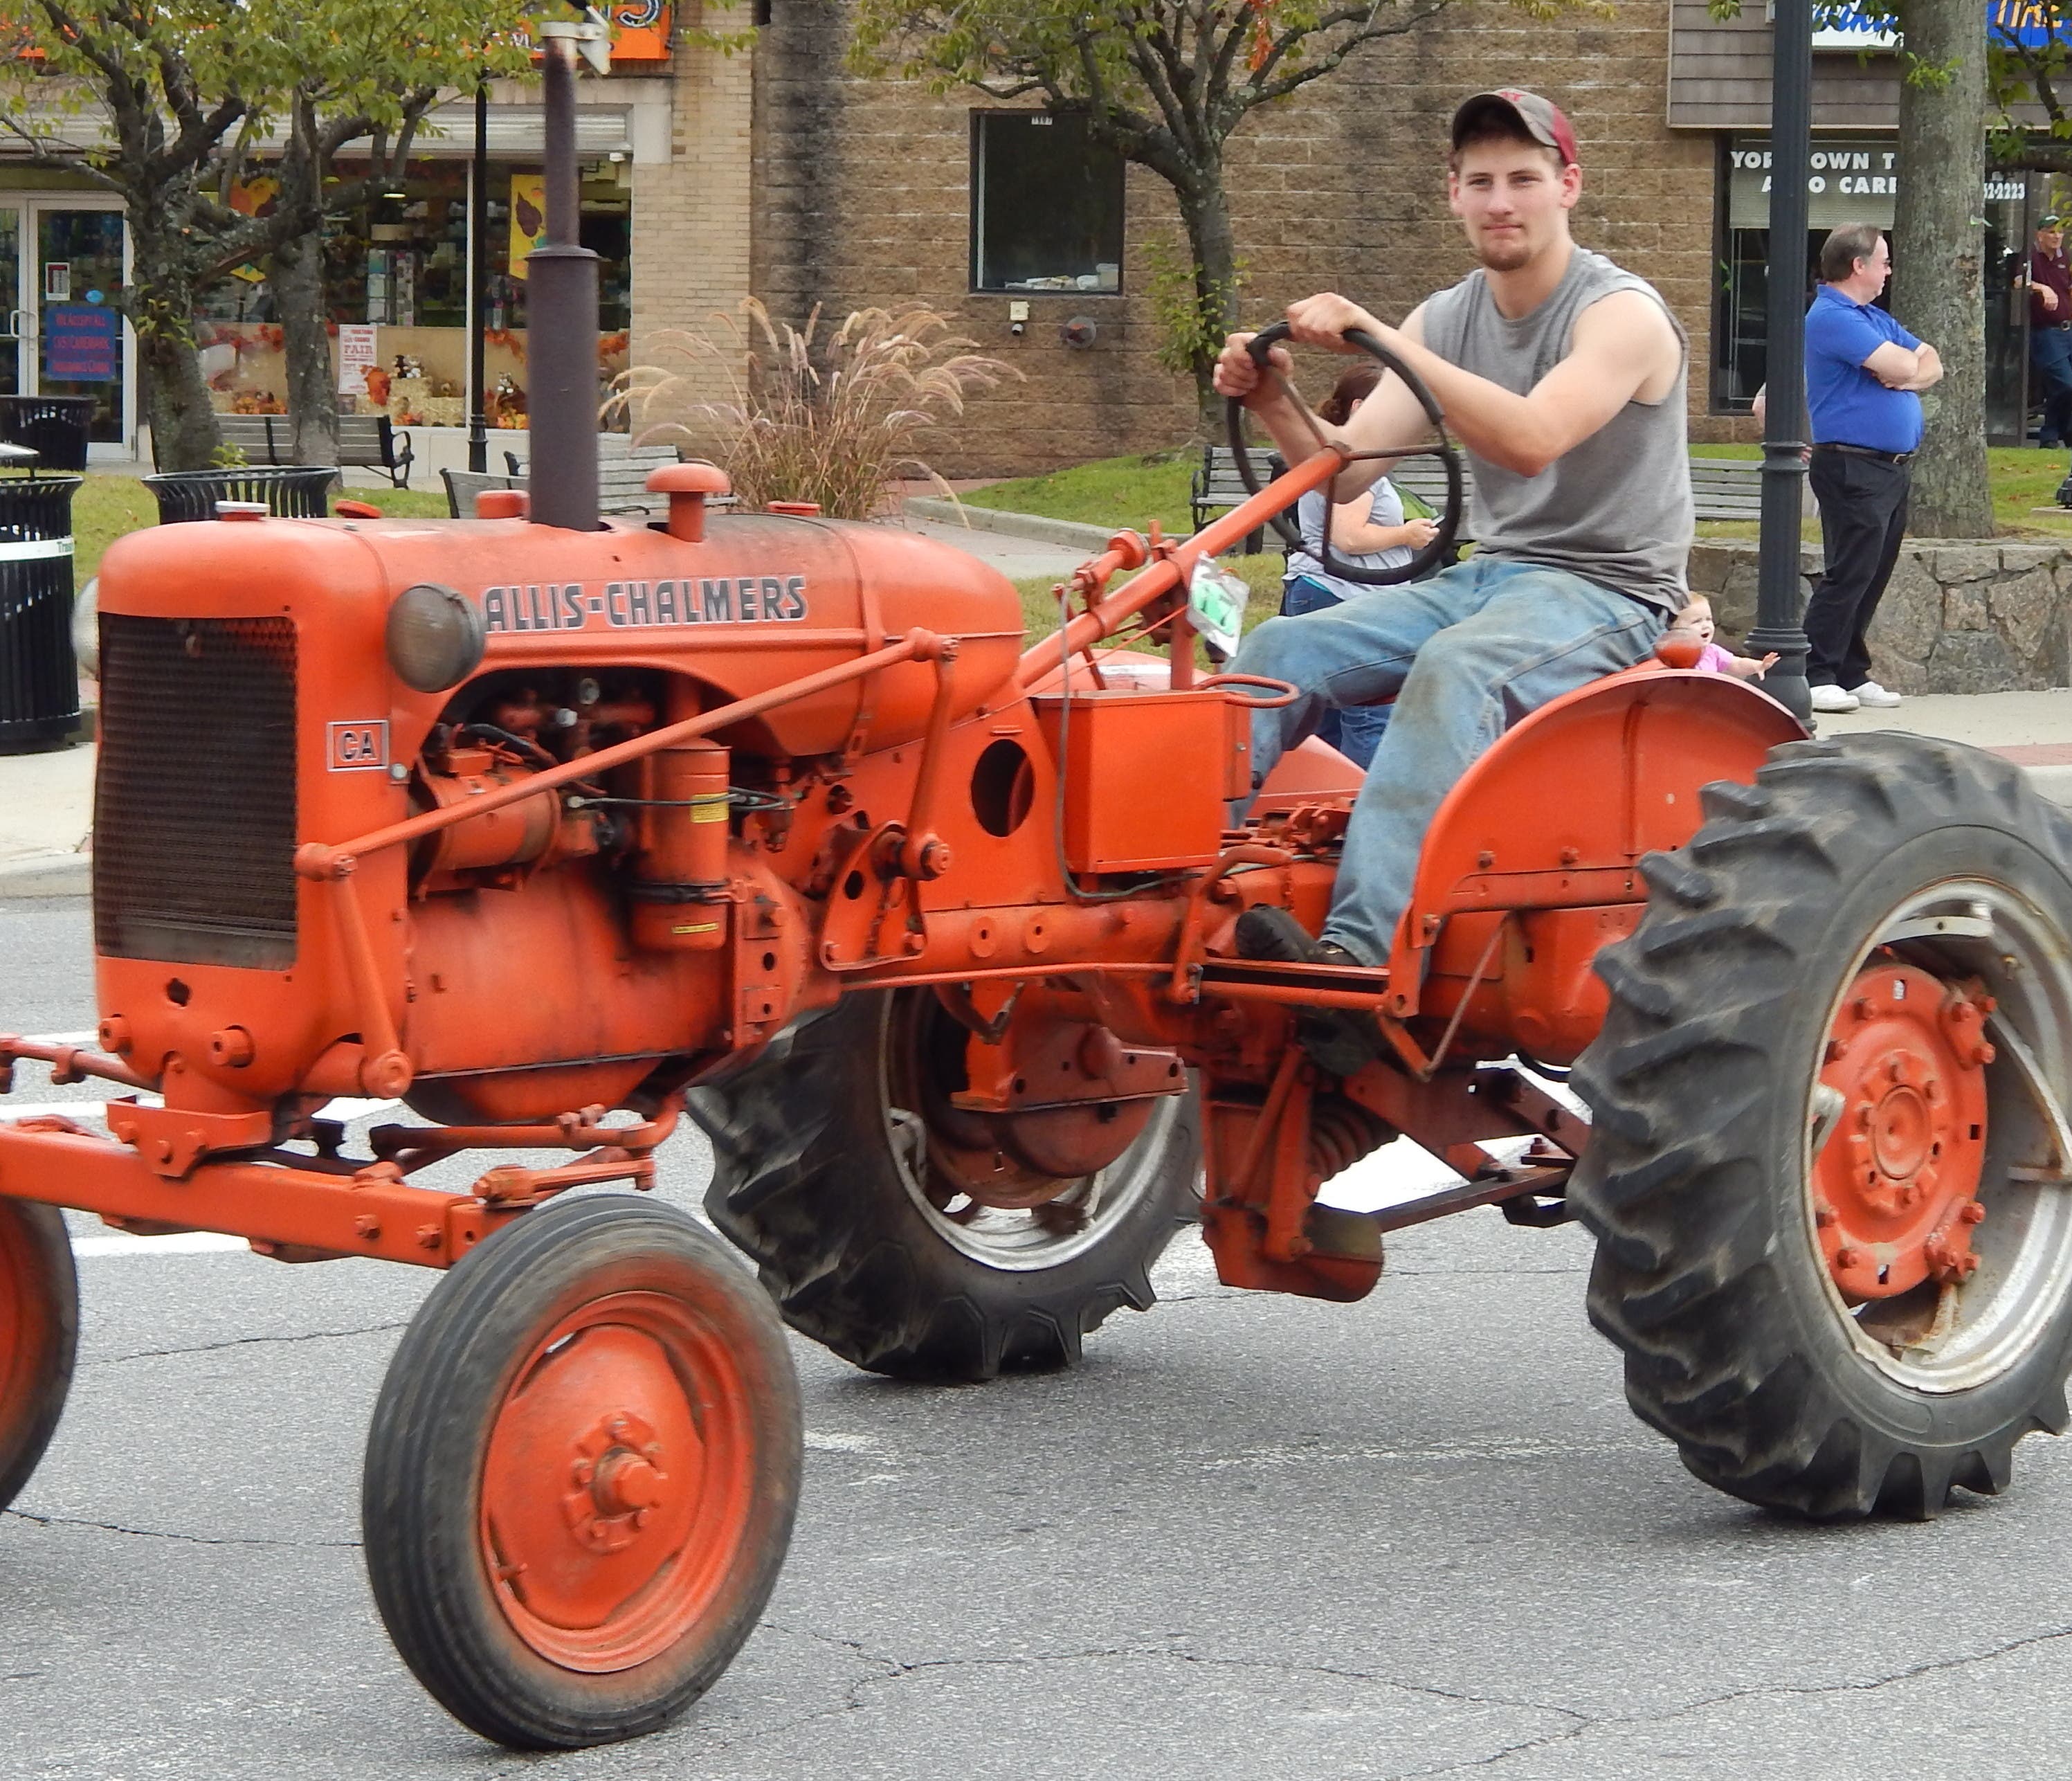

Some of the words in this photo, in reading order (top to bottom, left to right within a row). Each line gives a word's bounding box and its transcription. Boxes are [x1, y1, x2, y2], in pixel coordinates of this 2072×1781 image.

[1730, 151, 1870, 170] YOROWN
[1761, 175, 1826, 194] AO
[344, 345, 373, 354] FAIR
[483, 576, 807, 634] ALLIS-CHALMERS
[338, 730, 378, 761] CA
